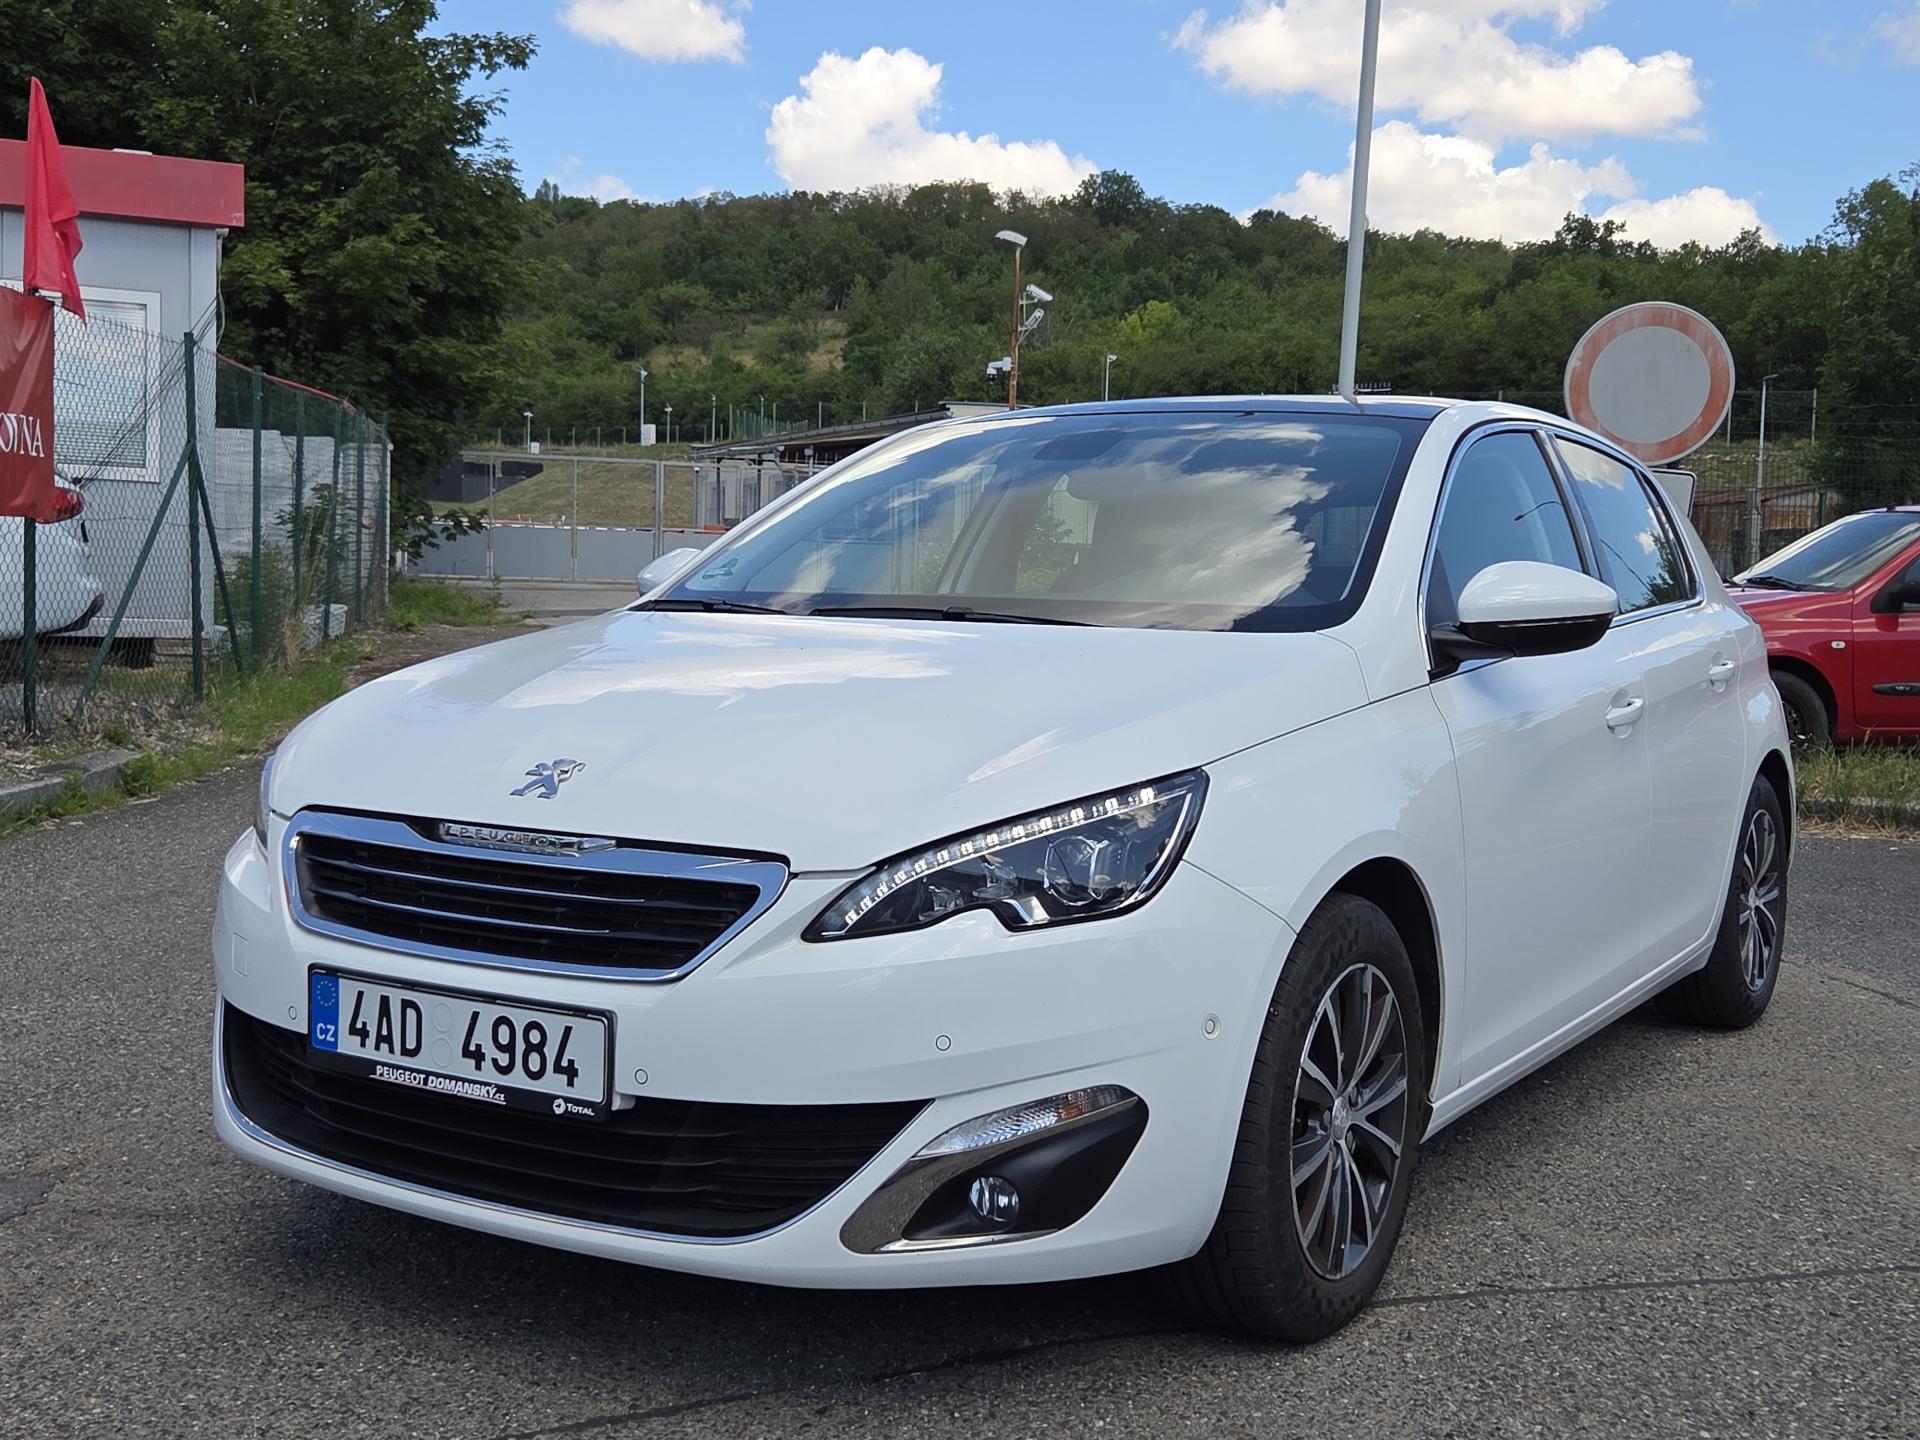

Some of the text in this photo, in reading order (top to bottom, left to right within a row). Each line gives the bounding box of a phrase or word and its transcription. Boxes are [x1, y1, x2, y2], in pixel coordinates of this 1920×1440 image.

[316, 1022, 335, 1042] CZ
[348, 989, 579, 1088] 4AD 4984
[376, 1065, 426, 1086] PEUGEOT
